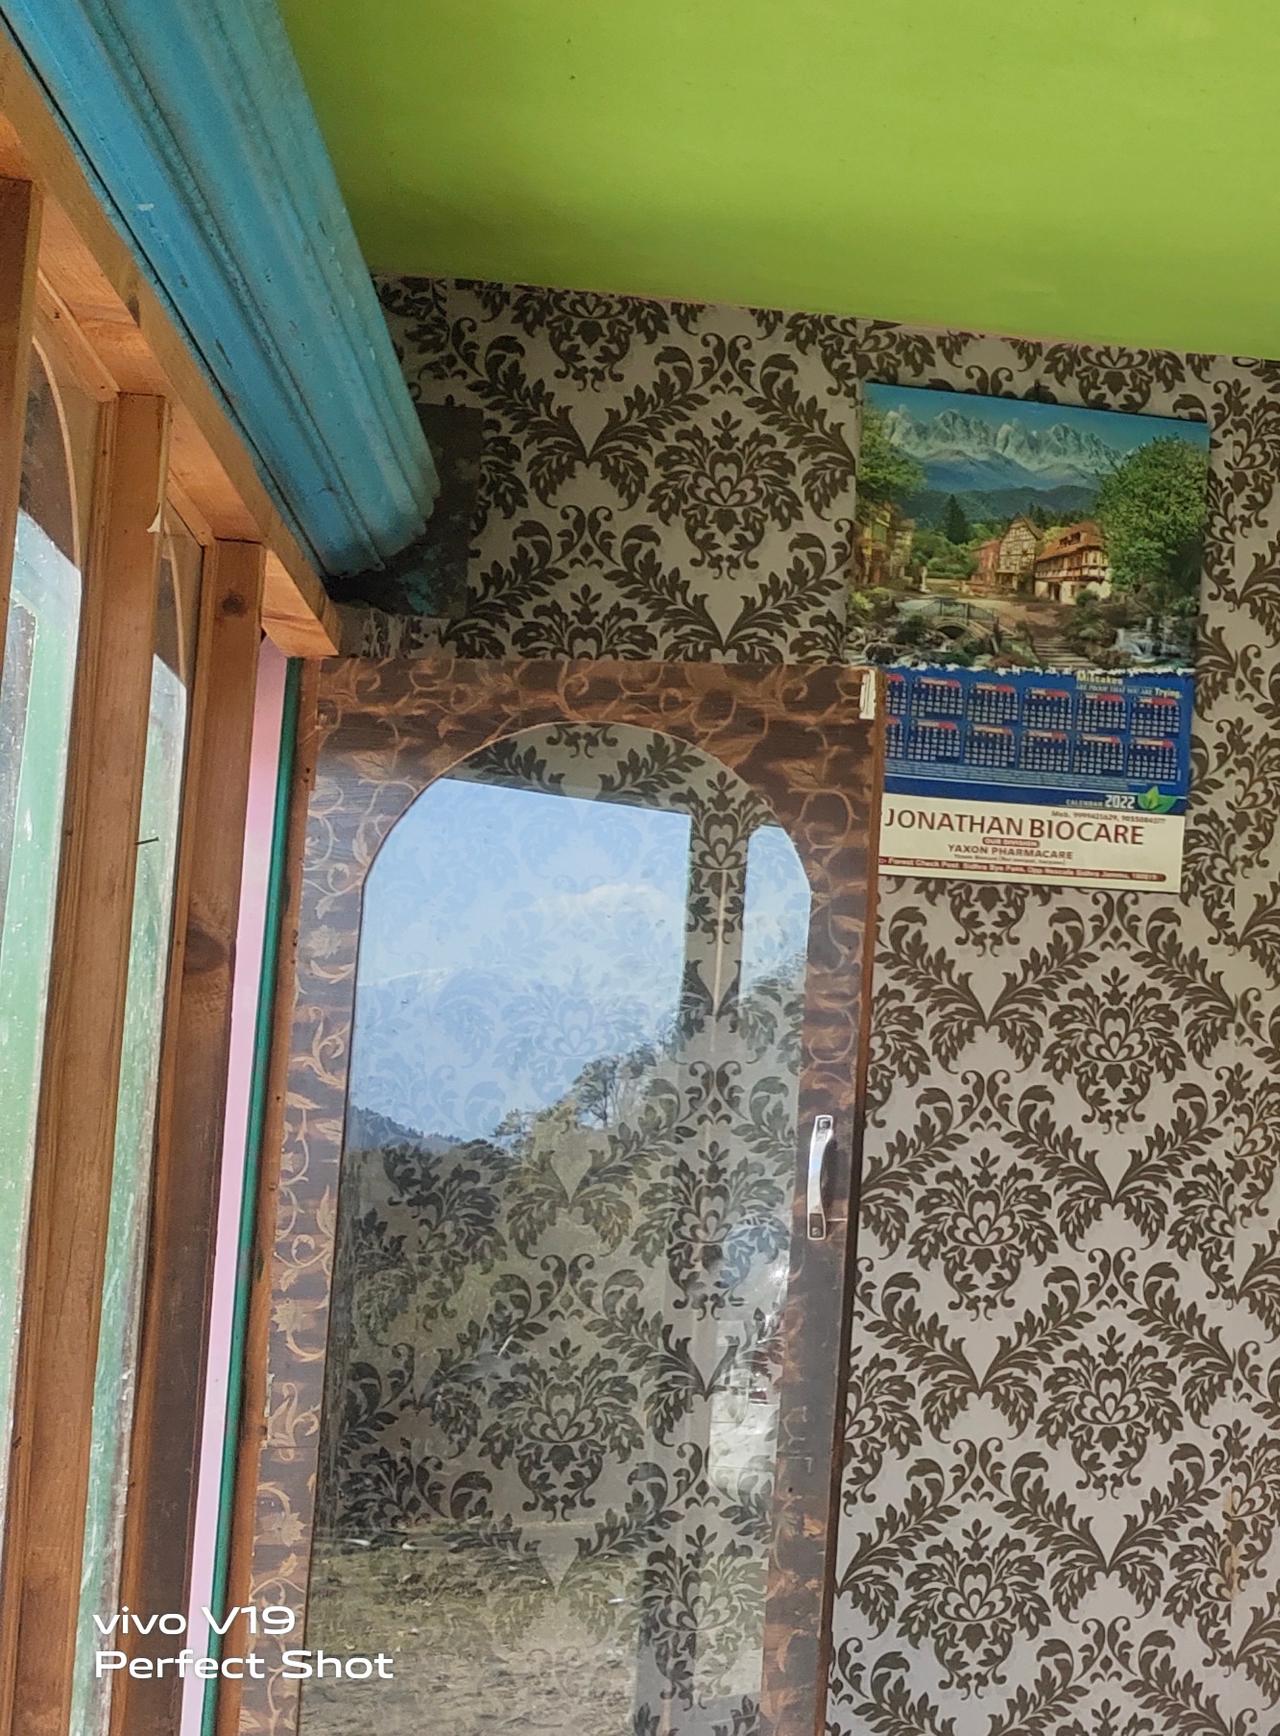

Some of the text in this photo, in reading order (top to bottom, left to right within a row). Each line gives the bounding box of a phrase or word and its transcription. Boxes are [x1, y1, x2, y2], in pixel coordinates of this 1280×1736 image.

[1104, 794, 1135, 809] 2022
[884, 808, 1145, 845] JONATHAN BIOCARE
[948, 844, 1073, 860] YAXON PHARMACARE
